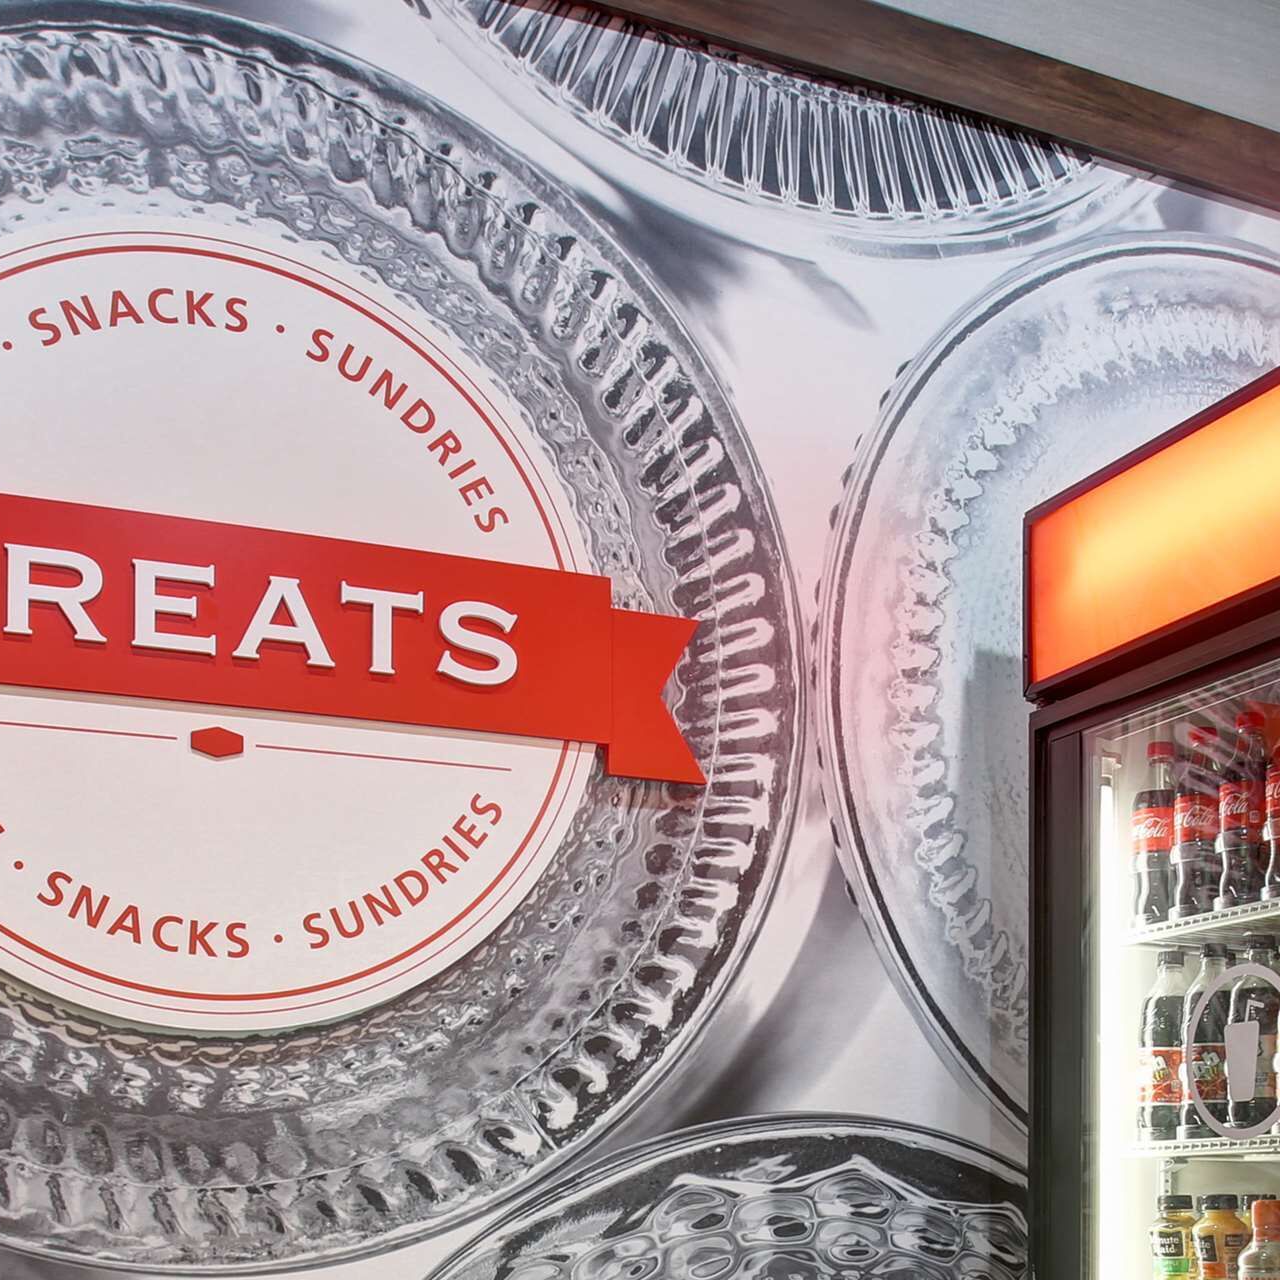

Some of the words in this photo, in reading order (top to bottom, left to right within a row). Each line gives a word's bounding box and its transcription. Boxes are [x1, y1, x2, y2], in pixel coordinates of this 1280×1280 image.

[28, 288, 249, 348] SNACKS
[305, 327, 509, 535] SUNDRIES
[36, 869, 251, 959] SNACKS
[303, 793, 503, 950] SUNDRIES
